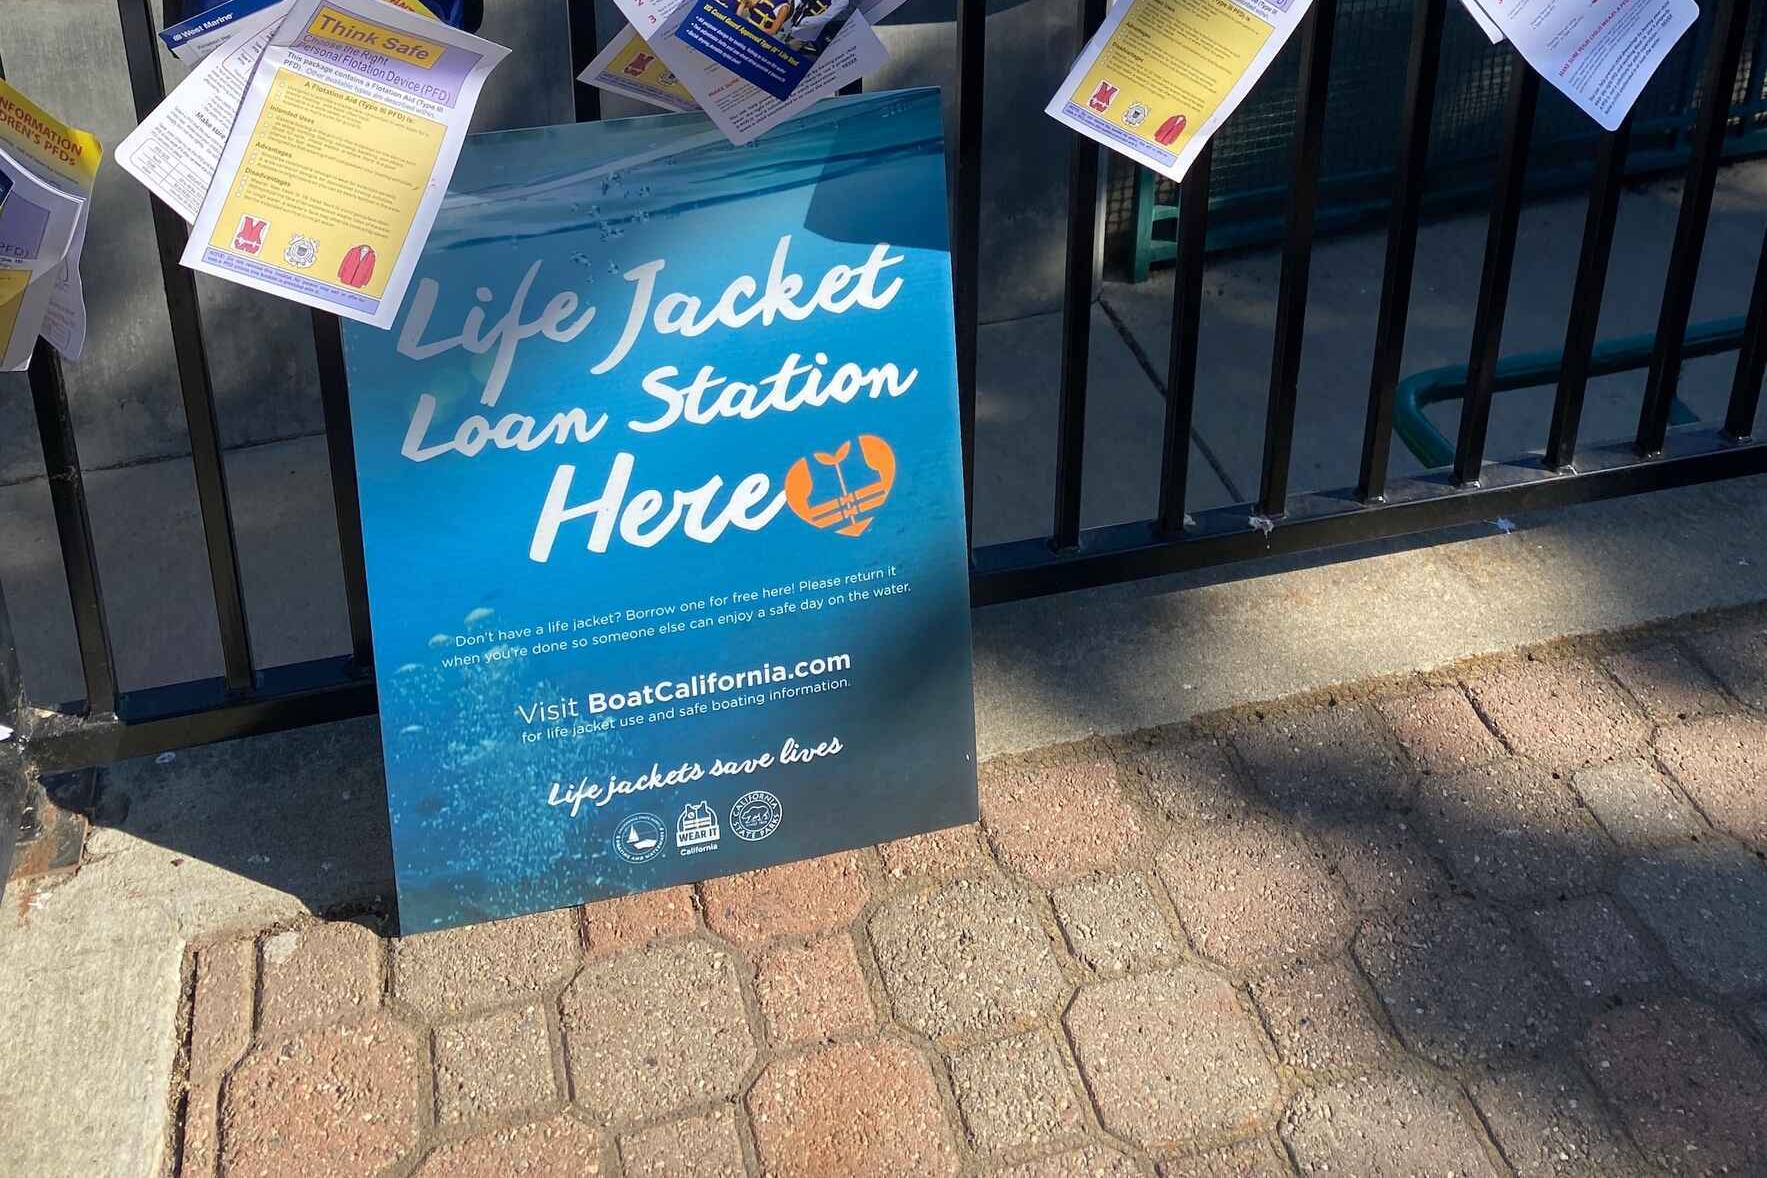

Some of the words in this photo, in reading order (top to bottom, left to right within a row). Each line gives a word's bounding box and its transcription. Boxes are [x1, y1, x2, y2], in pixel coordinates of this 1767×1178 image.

[319, 14, 379, 45] Think
[382, 36, 430, 60] Safe
[649, 15, 657, 23] 3
[298, 42, 343, 62] Personal
[342, 51, 386, 78] Flotation
[386, 70, 422, 93] Device
[420, 82, 451, 104] (PFD)
[343, 44, 360, 58] the
[361, 50, 389, 66] Right
[44, 140, 76, 167] PFDs
[397, 259, 596, 407] Life
[591, 235, 904, 375] Jacket
[401, 394, 608, 463] Loan
[628, 352, 918, 432] Station
[529, 452, 788, 563] Here
[442, 652, 480, 668] when
[485, 646, 528, 664] you're
[532, 640, 568, 655] done
[572, 638, 588, 648] so
[592, 626, 655, 644] someone
[659, 621, 685, 634] else
[690, 618, 714, 630] can
[718, 610, 754, 625] enjoy
[758, 608, 765, 618] a
[769, 602, 796, 616] safe
[800, 598, 824, 610] day
[828, 596, 844, 606] on
[849, 588, 869, 602] the
[873, 582, 912, 598] water.
[456, 631, 494, 647] Don't
[498, 627, 531, 641] have
[536, 626, 544, 635] a
[548, 621, 569, 633] life
[572, 612, 621, 630] jacket?
[626, 605, 676, 622] Borrow
[680, 600, 705, 614] one
[709, 596, 729, 607] for
[733, 591, 758, 604] free
[762, 582, 794, 599] here!
[800, 576, 840, 592] Please
[844, 568, 884, 584] return
[888, 566, 896, 576] it
[518, 698, 578, 724] Visit
[588, 654, 850, 713] BoatCalifornia.com
[522, 731, 542, 743] for
[547, 726, 568, 739] life
[572, 718, 615, 737] jacket
[620, 714, 644, 727] use
[649, 707, 674, 722] and
[680, 703, 708, 717] safe
[712, 693, 765, 711] boating
[769, 678, 851, 700] information.
[548, 777, 603, 817] Life
[596, 764, 705, 807] jackets
[708, 752, 774, 776] save
[780, 737, 843, 764] lives
[734, 792, 777, 817] CALIFORNIA
[679, 830, 706, 842] WEAR
[708, 828, 717, 837] IT
[680, 844, 718, 856] California
[734, 822, 756, 839] STATE
[760, 814, 779, 838] PARKS
